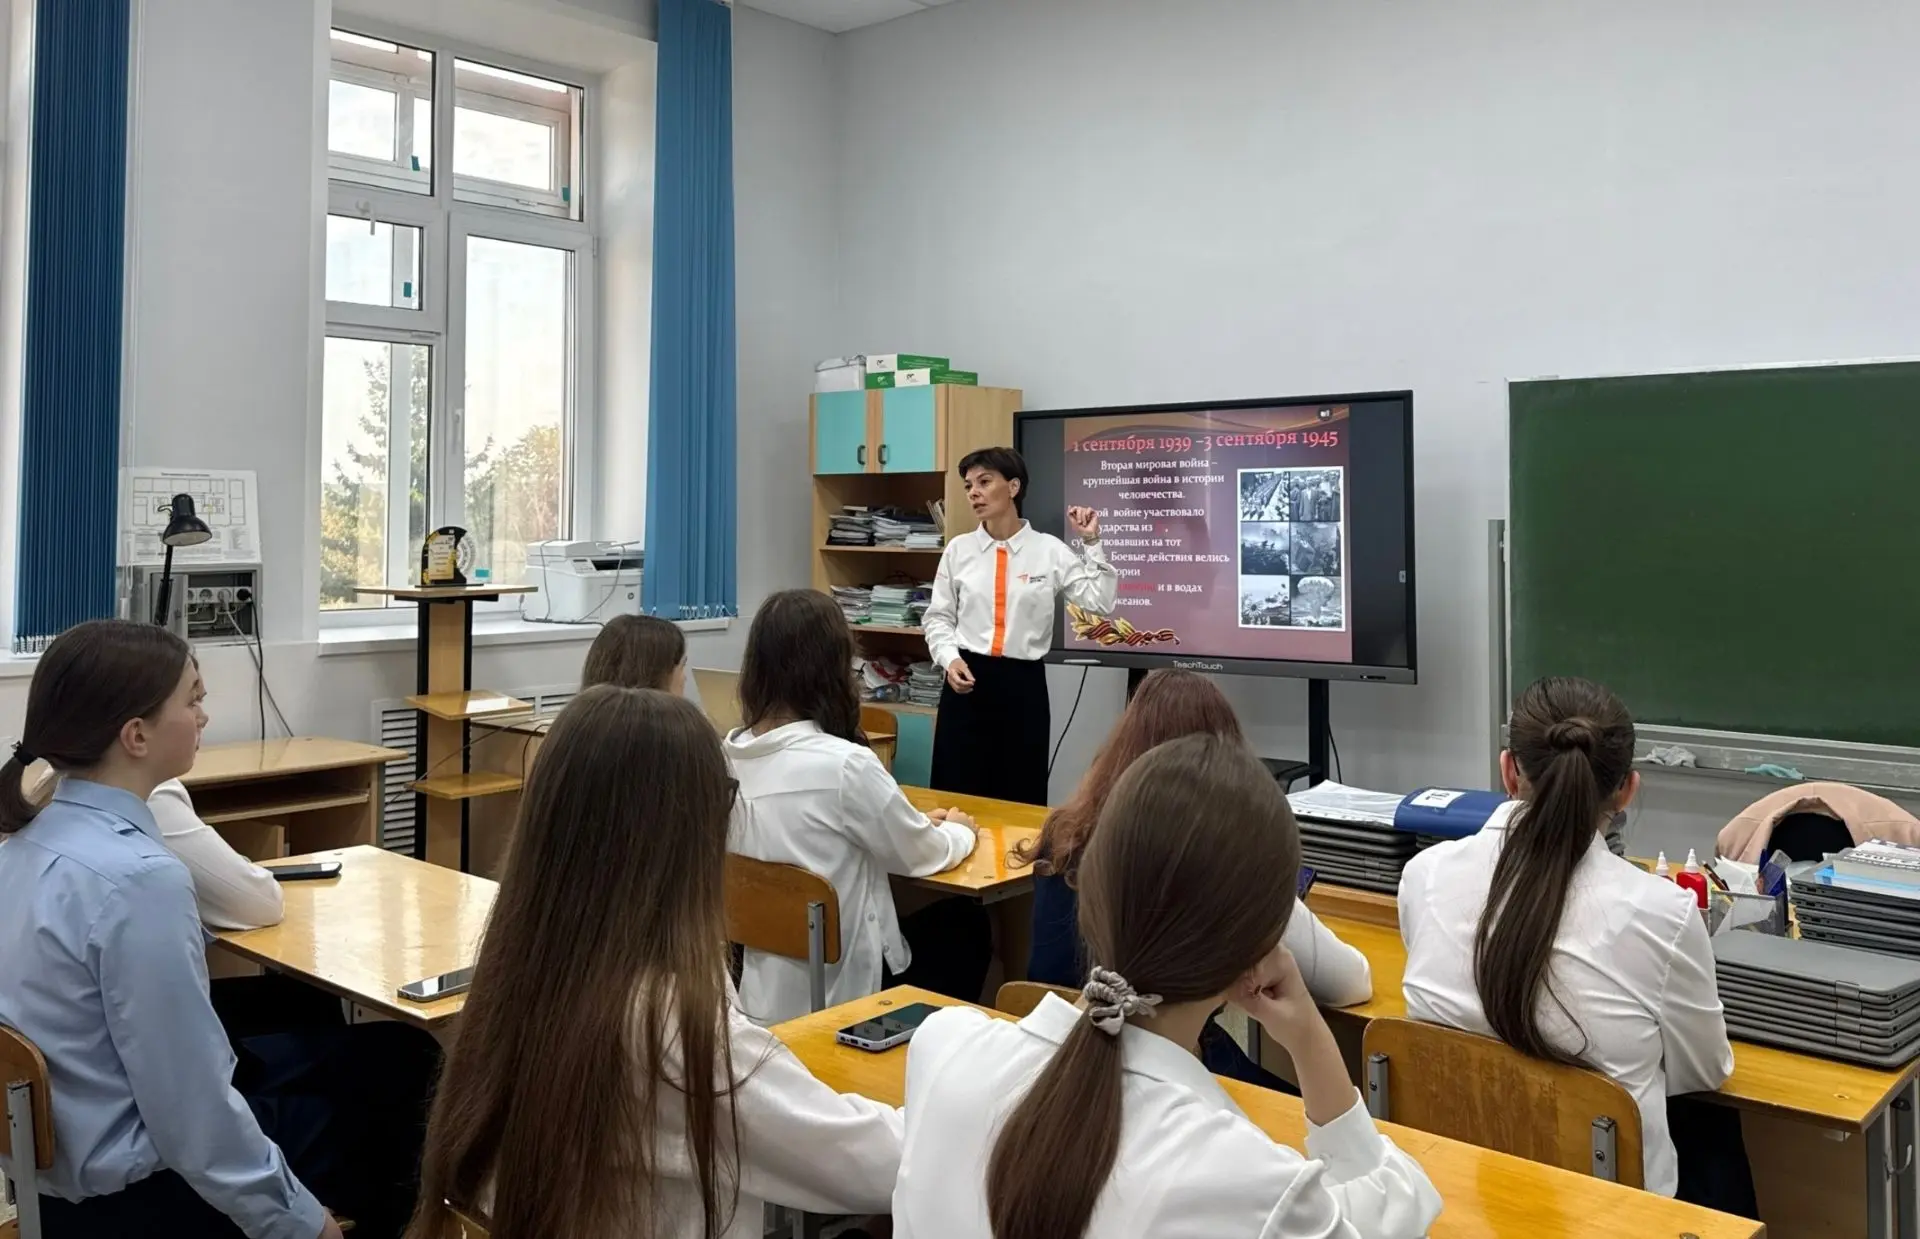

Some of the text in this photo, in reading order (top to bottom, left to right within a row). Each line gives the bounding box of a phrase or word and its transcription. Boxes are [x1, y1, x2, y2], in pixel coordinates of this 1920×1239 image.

[1073, 440, 1081, 452] 1
[1083, 434, 1154, 454] сентября
[1160, 437, 1191, 452] 1939
[1215, 429, 1298, 449] сентября
[1301, 431, 1338, 448] 1945
[1101, 460, 1133, 472] Вторая
[1135, 460, 1177, 472] мировая
[1180, 458, 1209, 468] война
[1083, 473, 1225, 488] крупнейшая война в истории
[1118, 490, 1185, 499] человечества.
[1113, 508, 1142, 517] войне
[1144, 508, 1205, 520] участвовало
[1098, 524, 1139, 535] ударства
[1141, 524, 1153, 532] из
[1151, 539, 1163, 547] на
[1165, 539, 1182, 547] тот
[1111, 551, 1146, 561] Боевые
[1147, 552, 1193, 563] действия
[1195, 554, 1230, 563] велись
[1175, 584, 1203, 593] водах
[1115, 597, 1153, 606] кеанов.
